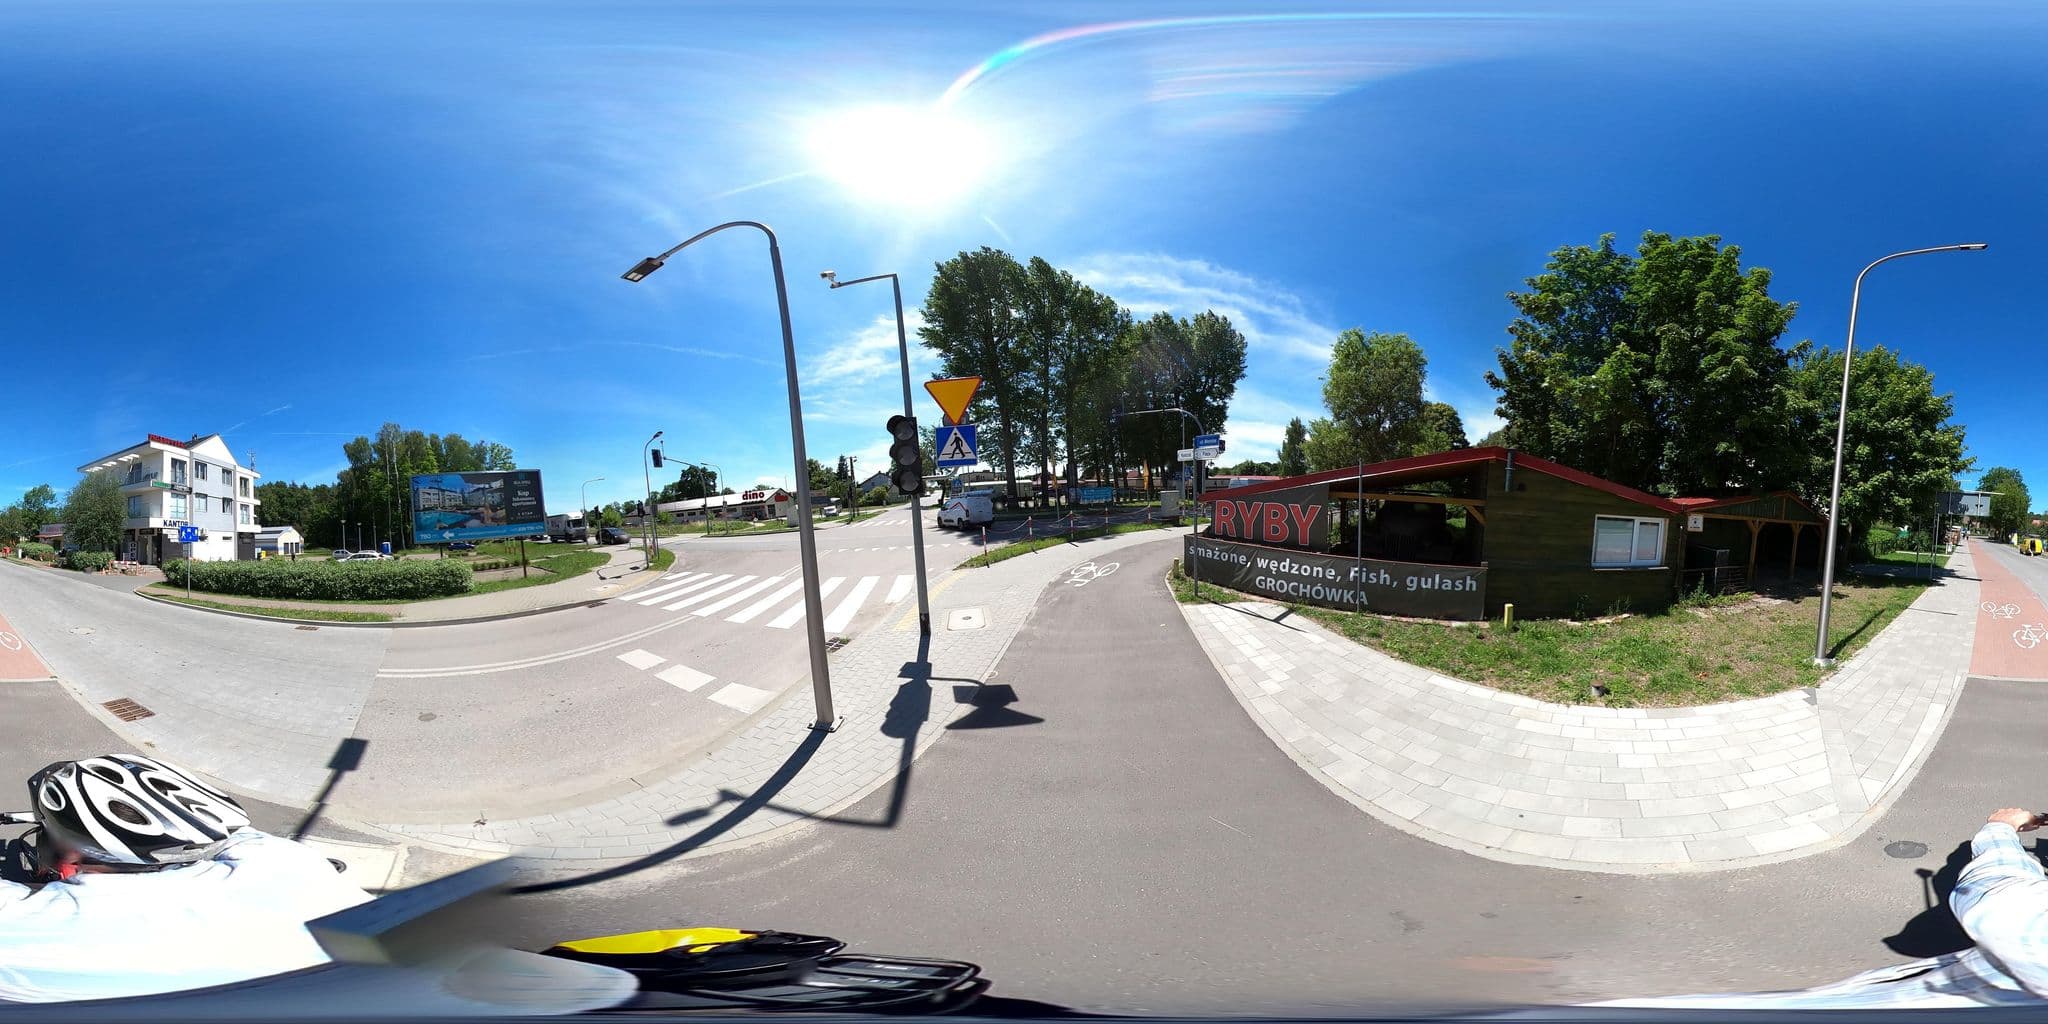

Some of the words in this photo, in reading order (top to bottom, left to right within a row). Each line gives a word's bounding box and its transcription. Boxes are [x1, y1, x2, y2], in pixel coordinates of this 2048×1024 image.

[742, 490, 765, 500] dino
[1214, 500, 1322, 546] RYBY
[1189, 546, 1251, 568] smażone,
[1256, 557, 1342, 583] wędzone,
[1350, 566, 1398, 588] Fish,
[1406, 573, 1477, 592] gulash
[1255, 576, 1369, 606] GROCHÓWKA
